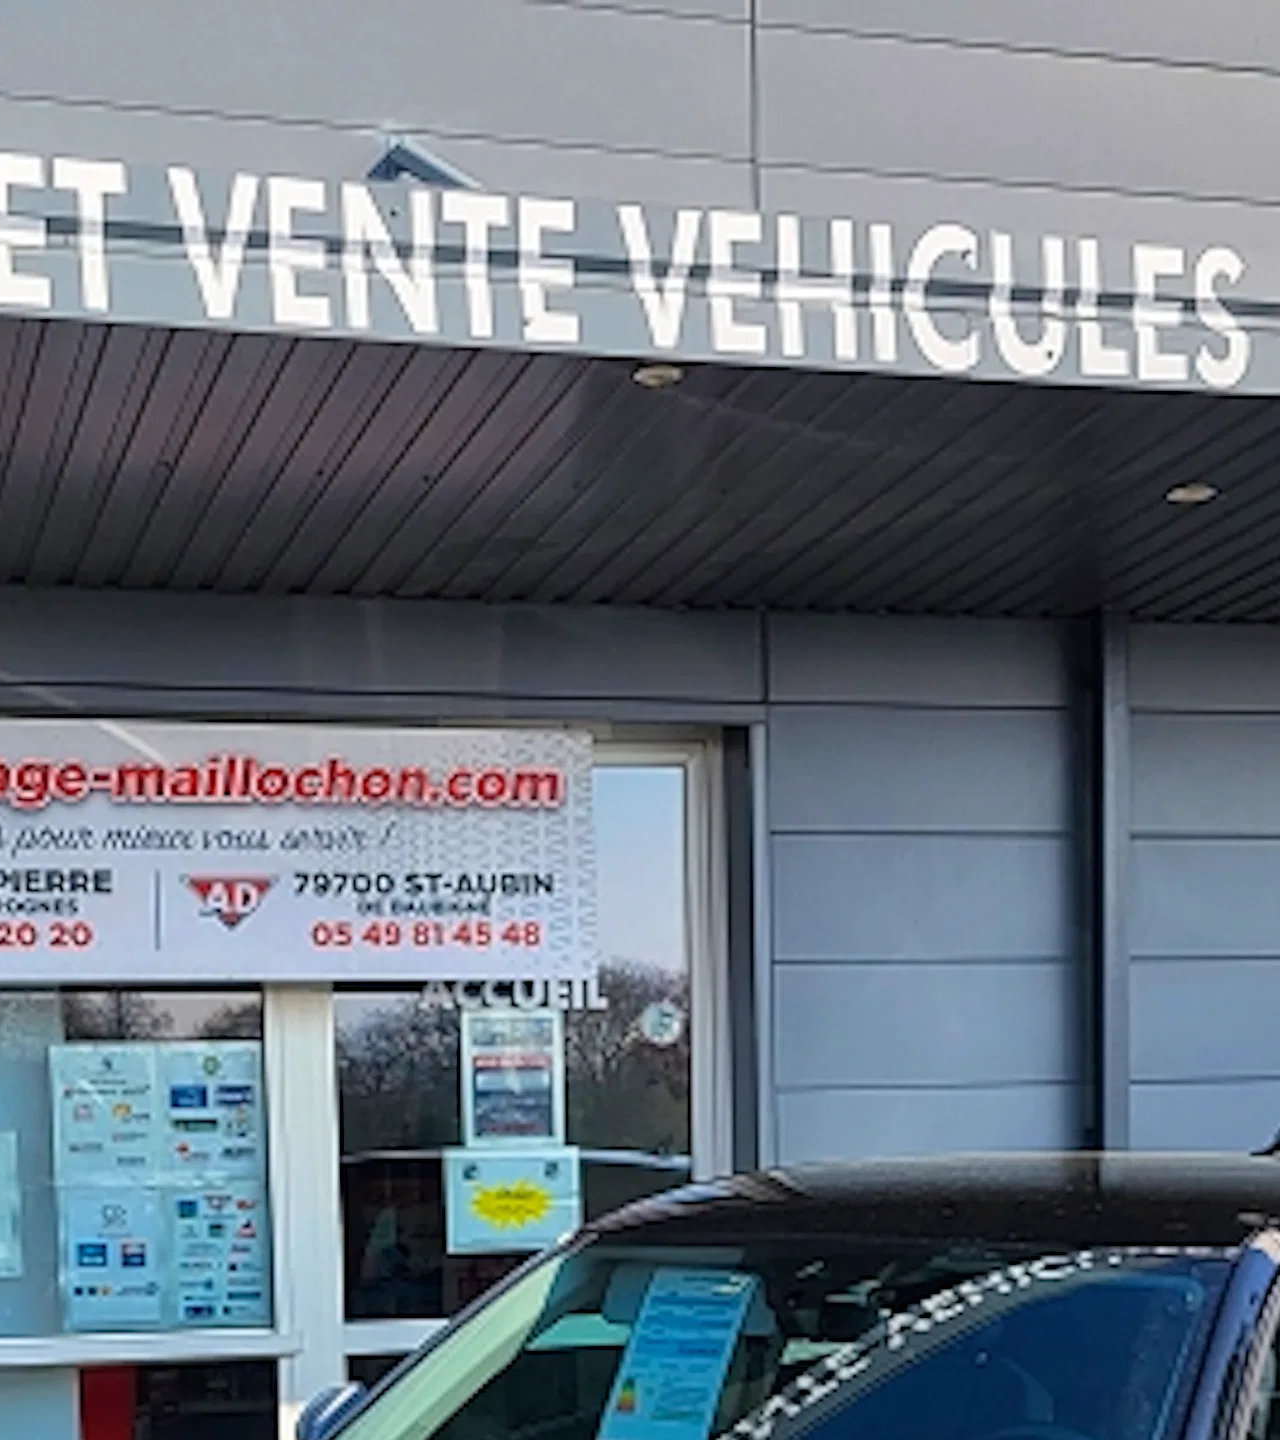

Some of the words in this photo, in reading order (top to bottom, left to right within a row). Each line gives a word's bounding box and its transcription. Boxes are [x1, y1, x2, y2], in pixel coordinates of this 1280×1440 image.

[167, 166, 580, 346] VENTE
[617, 205, 1248, 390] VEHICULES
[201, 882, 261, 912] AD
[294, 873, 394, 896] 79700
[405, 873, 553, 896] ST-AUBIN
[48, 921, 94, 947] 20
[311, 921, 352, 947] 05
[362, 921, 401, 946] 49
[413, 921, 444, 946] 81
[453, 921, 492, 946] 45
[502, 921, 541, 946] 48
[419, 978, 609, 1011] ACCUEIL
